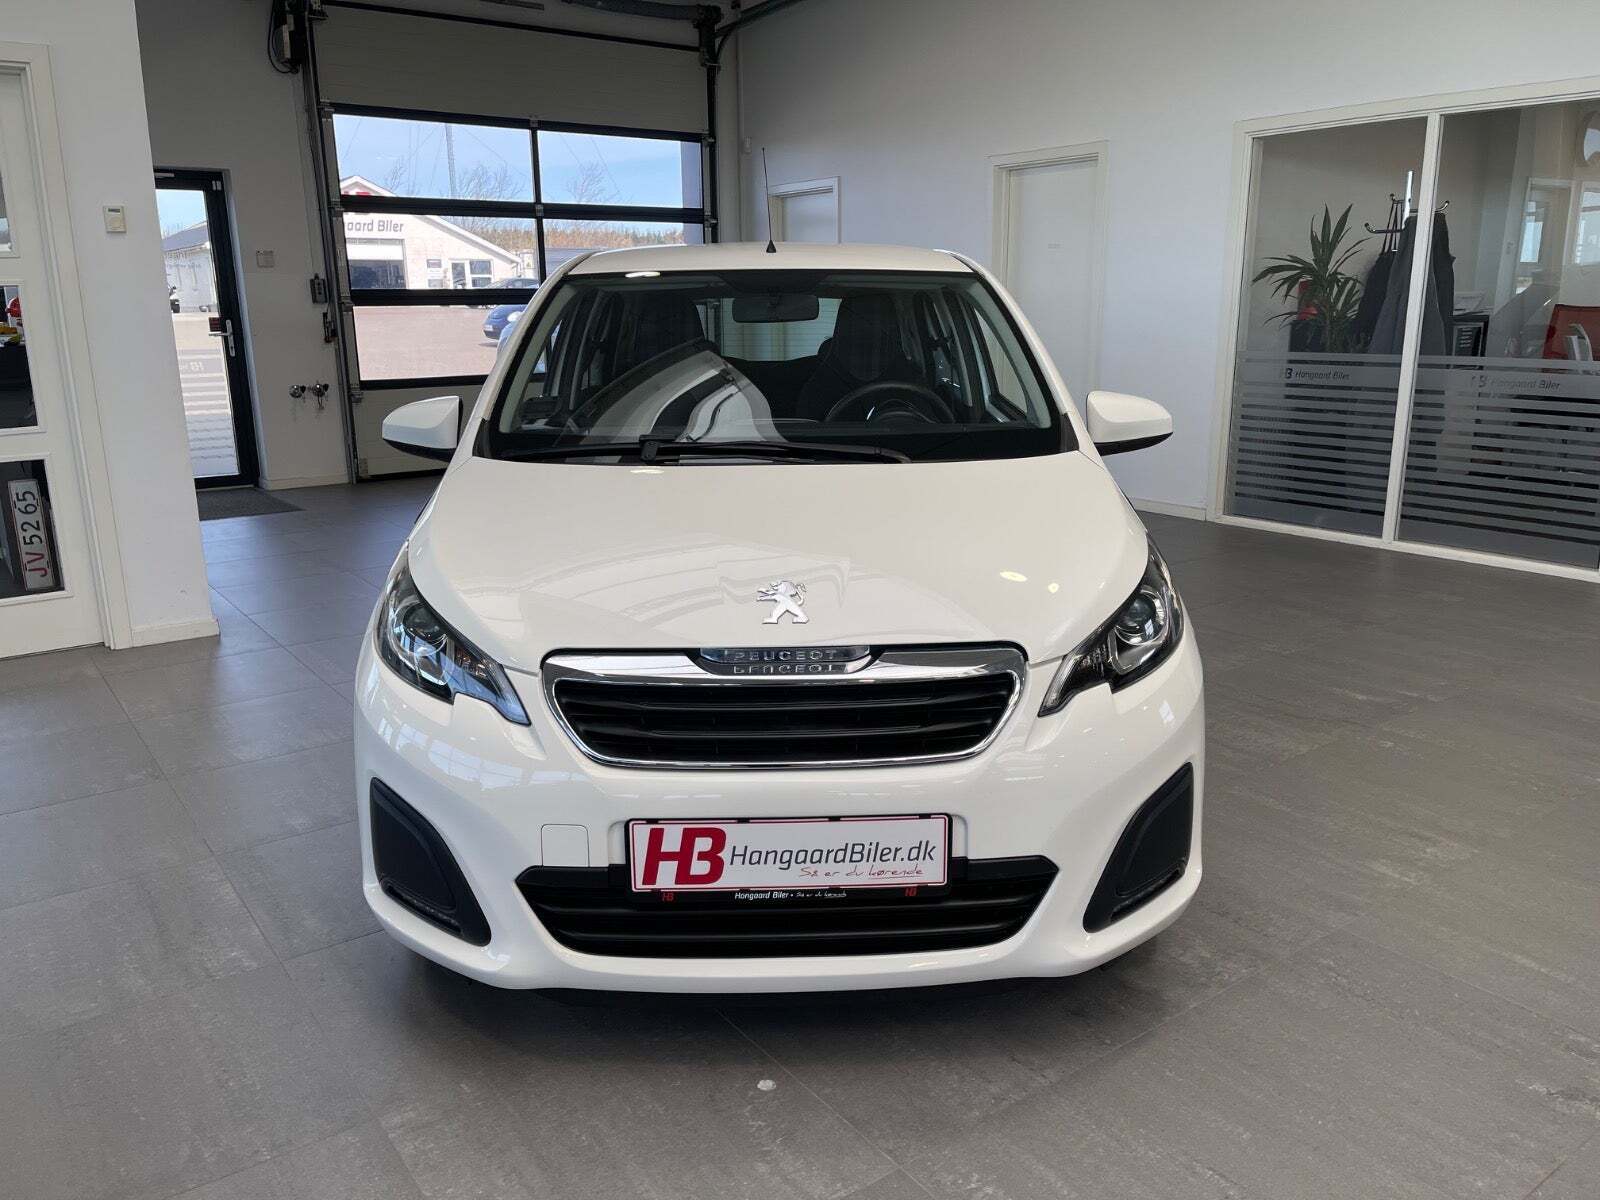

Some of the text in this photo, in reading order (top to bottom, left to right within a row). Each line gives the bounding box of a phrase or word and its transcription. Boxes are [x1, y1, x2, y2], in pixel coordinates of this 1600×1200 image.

[378, 219, 404, 233] Biler
[16, 490, 48, 577] JV 52 65
[641, 827, 936, 886] HB HangaardBiler.dk
[734, 891, 771, 901] Hangaard
[773, 891, 790, 899] Biler
